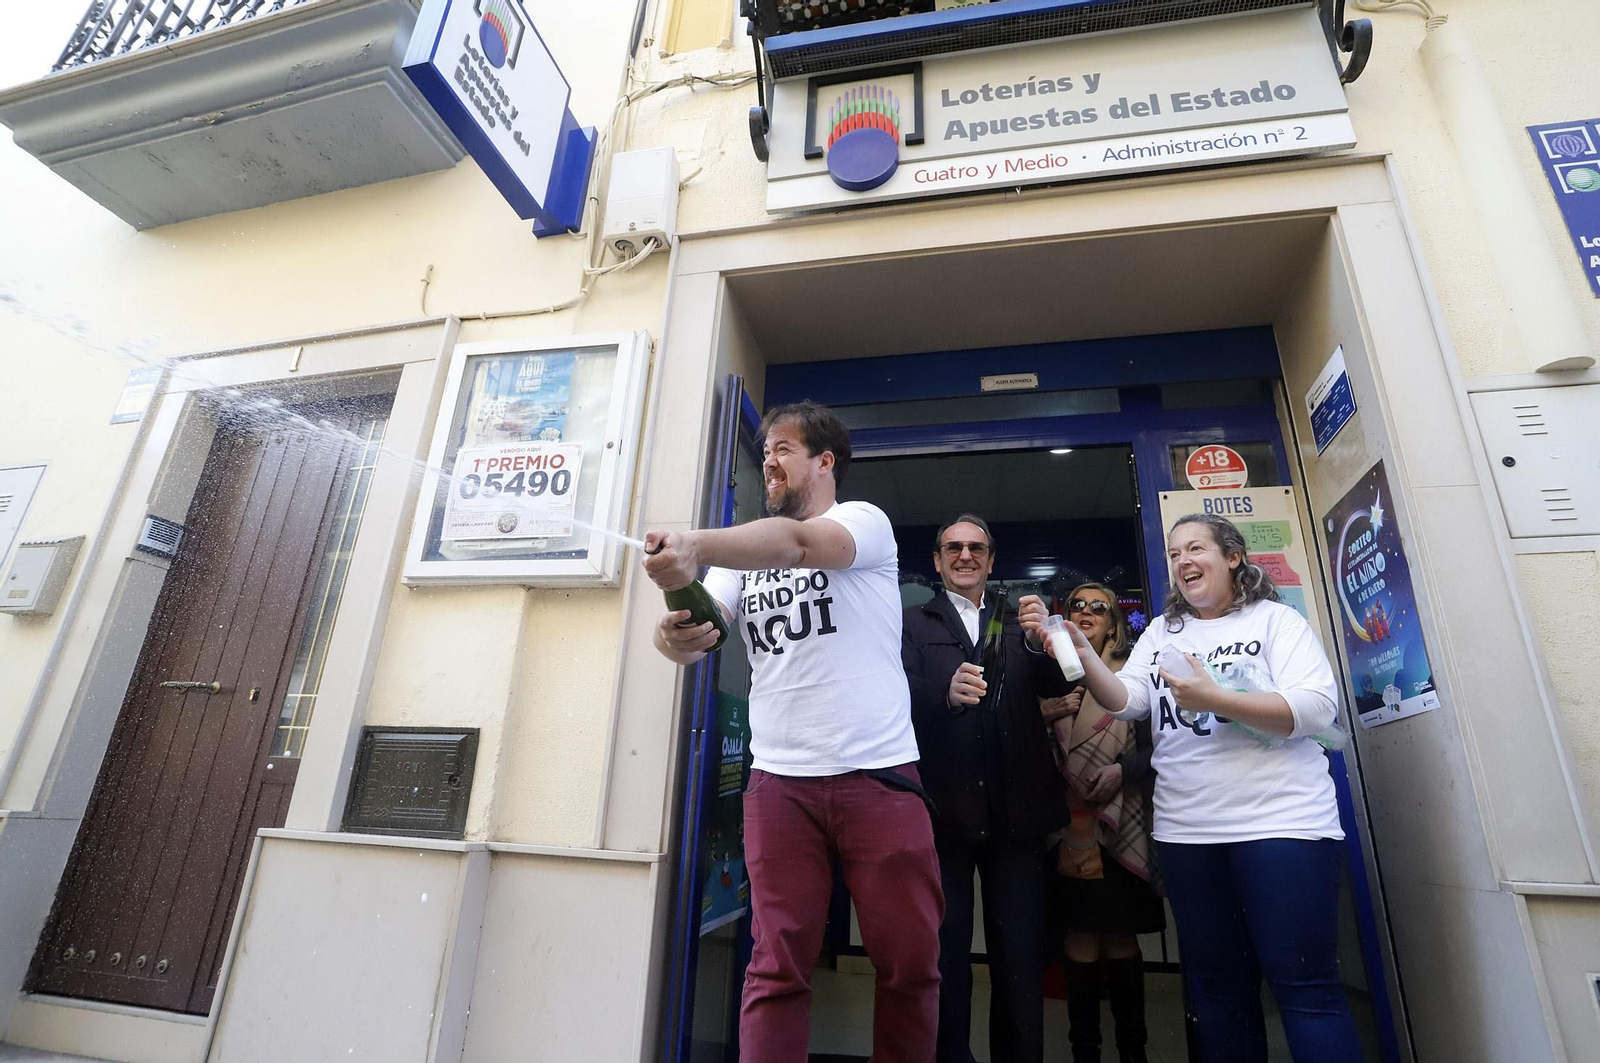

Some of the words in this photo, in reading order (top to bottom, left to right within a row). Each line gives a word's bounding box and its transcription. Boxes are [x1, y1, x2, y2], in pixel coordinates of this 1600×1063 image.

[454, 65, 496, 129] Estado
[458, 53, 512, 131] Apuestas
[513, 131, 531, 157] del
[941, 76, 1074, 107] Loterías
[1082, 73, 1101, 94] y
[510, 105, 519, 120] y
[943, 107, 1099, 142] Apuestas
[1108, 93, 1161, 120] del
[1170, 80, 1296, 113] Estado
[914, 166, 979, 184] Cuatro
[986, 164, 998, 180] y
[1005, 153, 1069, 173] Medio
[1102, 132, 1258, 163] Administración
[1293, 126, 1308, 141] 2
[486, 454, 565, 472] PREMIO
[1196, 450, 1230, 468] +18
[460, 469, 572, 499] 05490
[1203, 496, 1253, 515] BOTES
[1348, 530, 1372, 558] SORTEO
[1346, 571, 1360, 594] EL
[1358, 552, 1386, 586] NIÑO
[1368, 578, 1386, 597] ENERO
[746, 592, 838, 656] AQUÍ
[721, 732, 744, 756] OJALÁ
